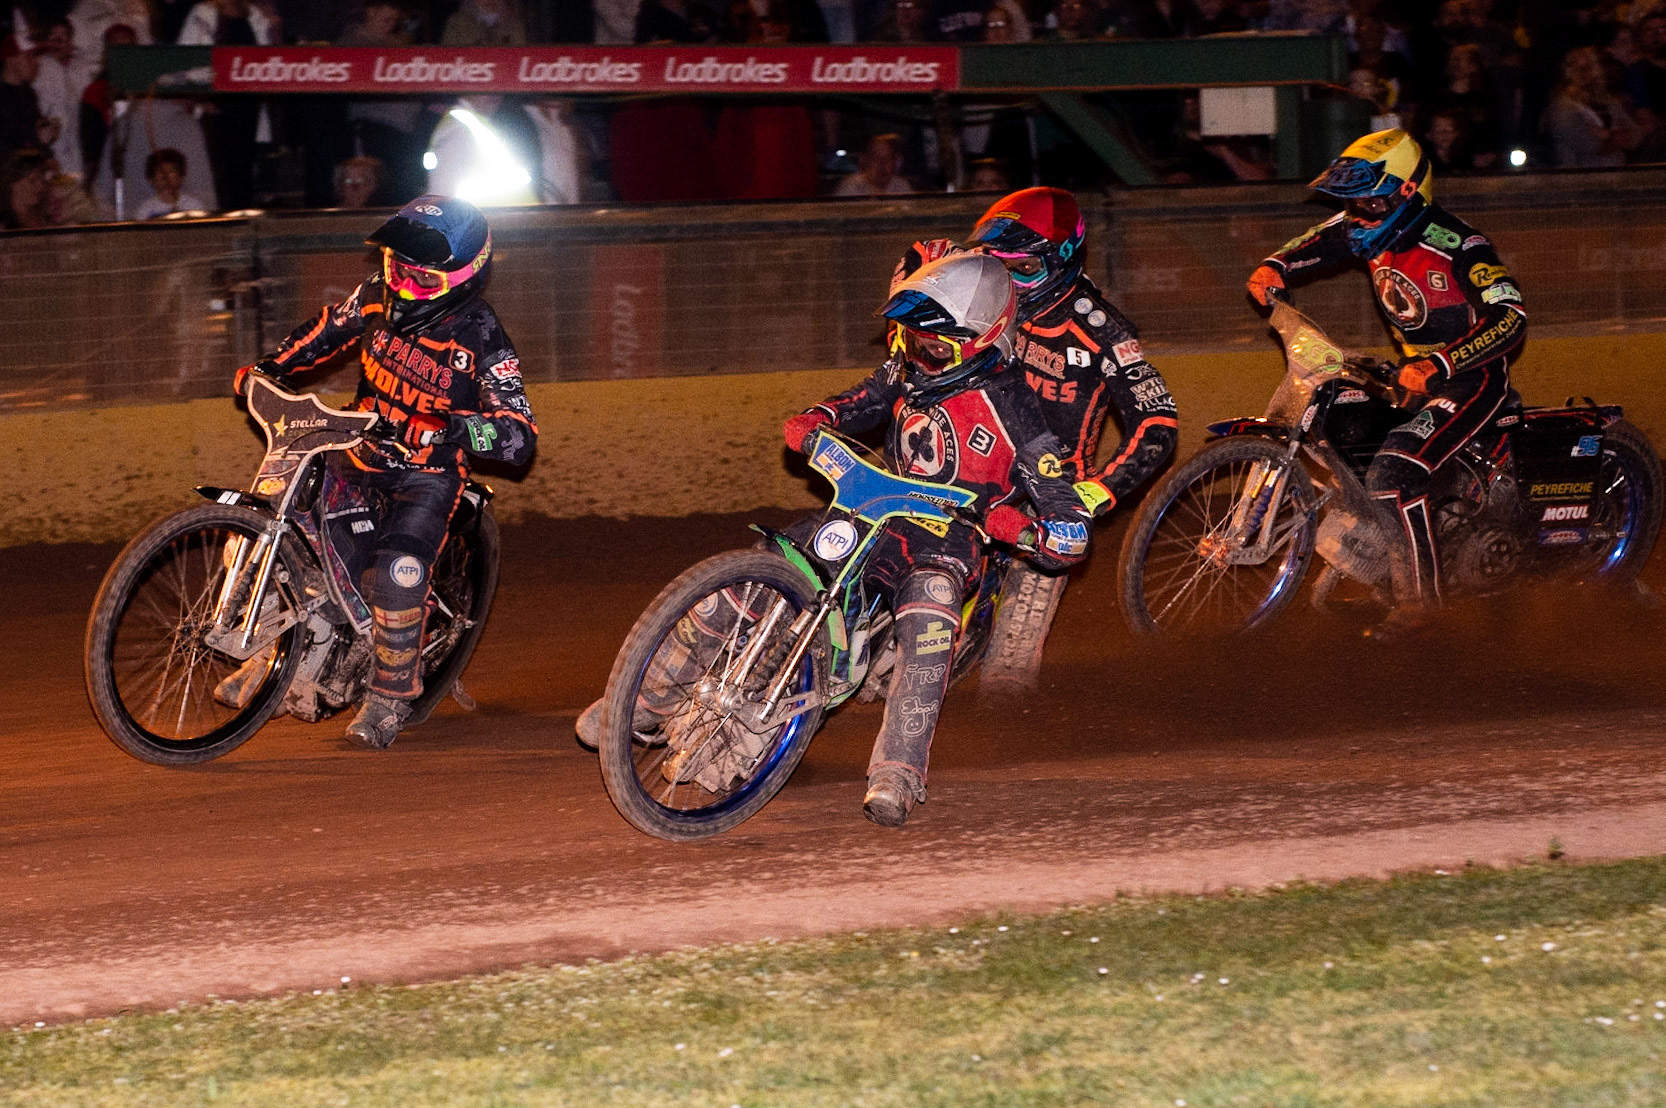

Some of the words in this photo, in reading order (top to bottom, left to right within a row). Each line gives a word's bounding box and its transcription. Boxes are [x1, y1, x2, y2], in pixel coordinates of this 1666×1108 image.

[230, 56, 350, 82] Ladbrokes
[374, 56, 496, 82] Ladbrokes
[518, 56, 641, 82] Ladbrokes
[665, 57, 787, 83] Ladbrokes
[811, 57, 938, 83] Ladbrokes
[1450, 308, 1519, 364] PEYREFICHE
[454, 350, 469, 370] 3
[1075, 352, 1083, 366] 5
[290, 418, 329, 429] STELLAR
[944, 431, 955, 462] ACES
[972, 430, 991, 447] 3
[1530, 482, 1594, 496] PEYREFICHE
[1541, 505, 1589, 521] MOTUL
[823, 531, 849, 550] ATPI
[397, 565, 419, 577] ATPI
[917, 639, 939, 649] ROCK
[939, 636, 950, 645] OIL
